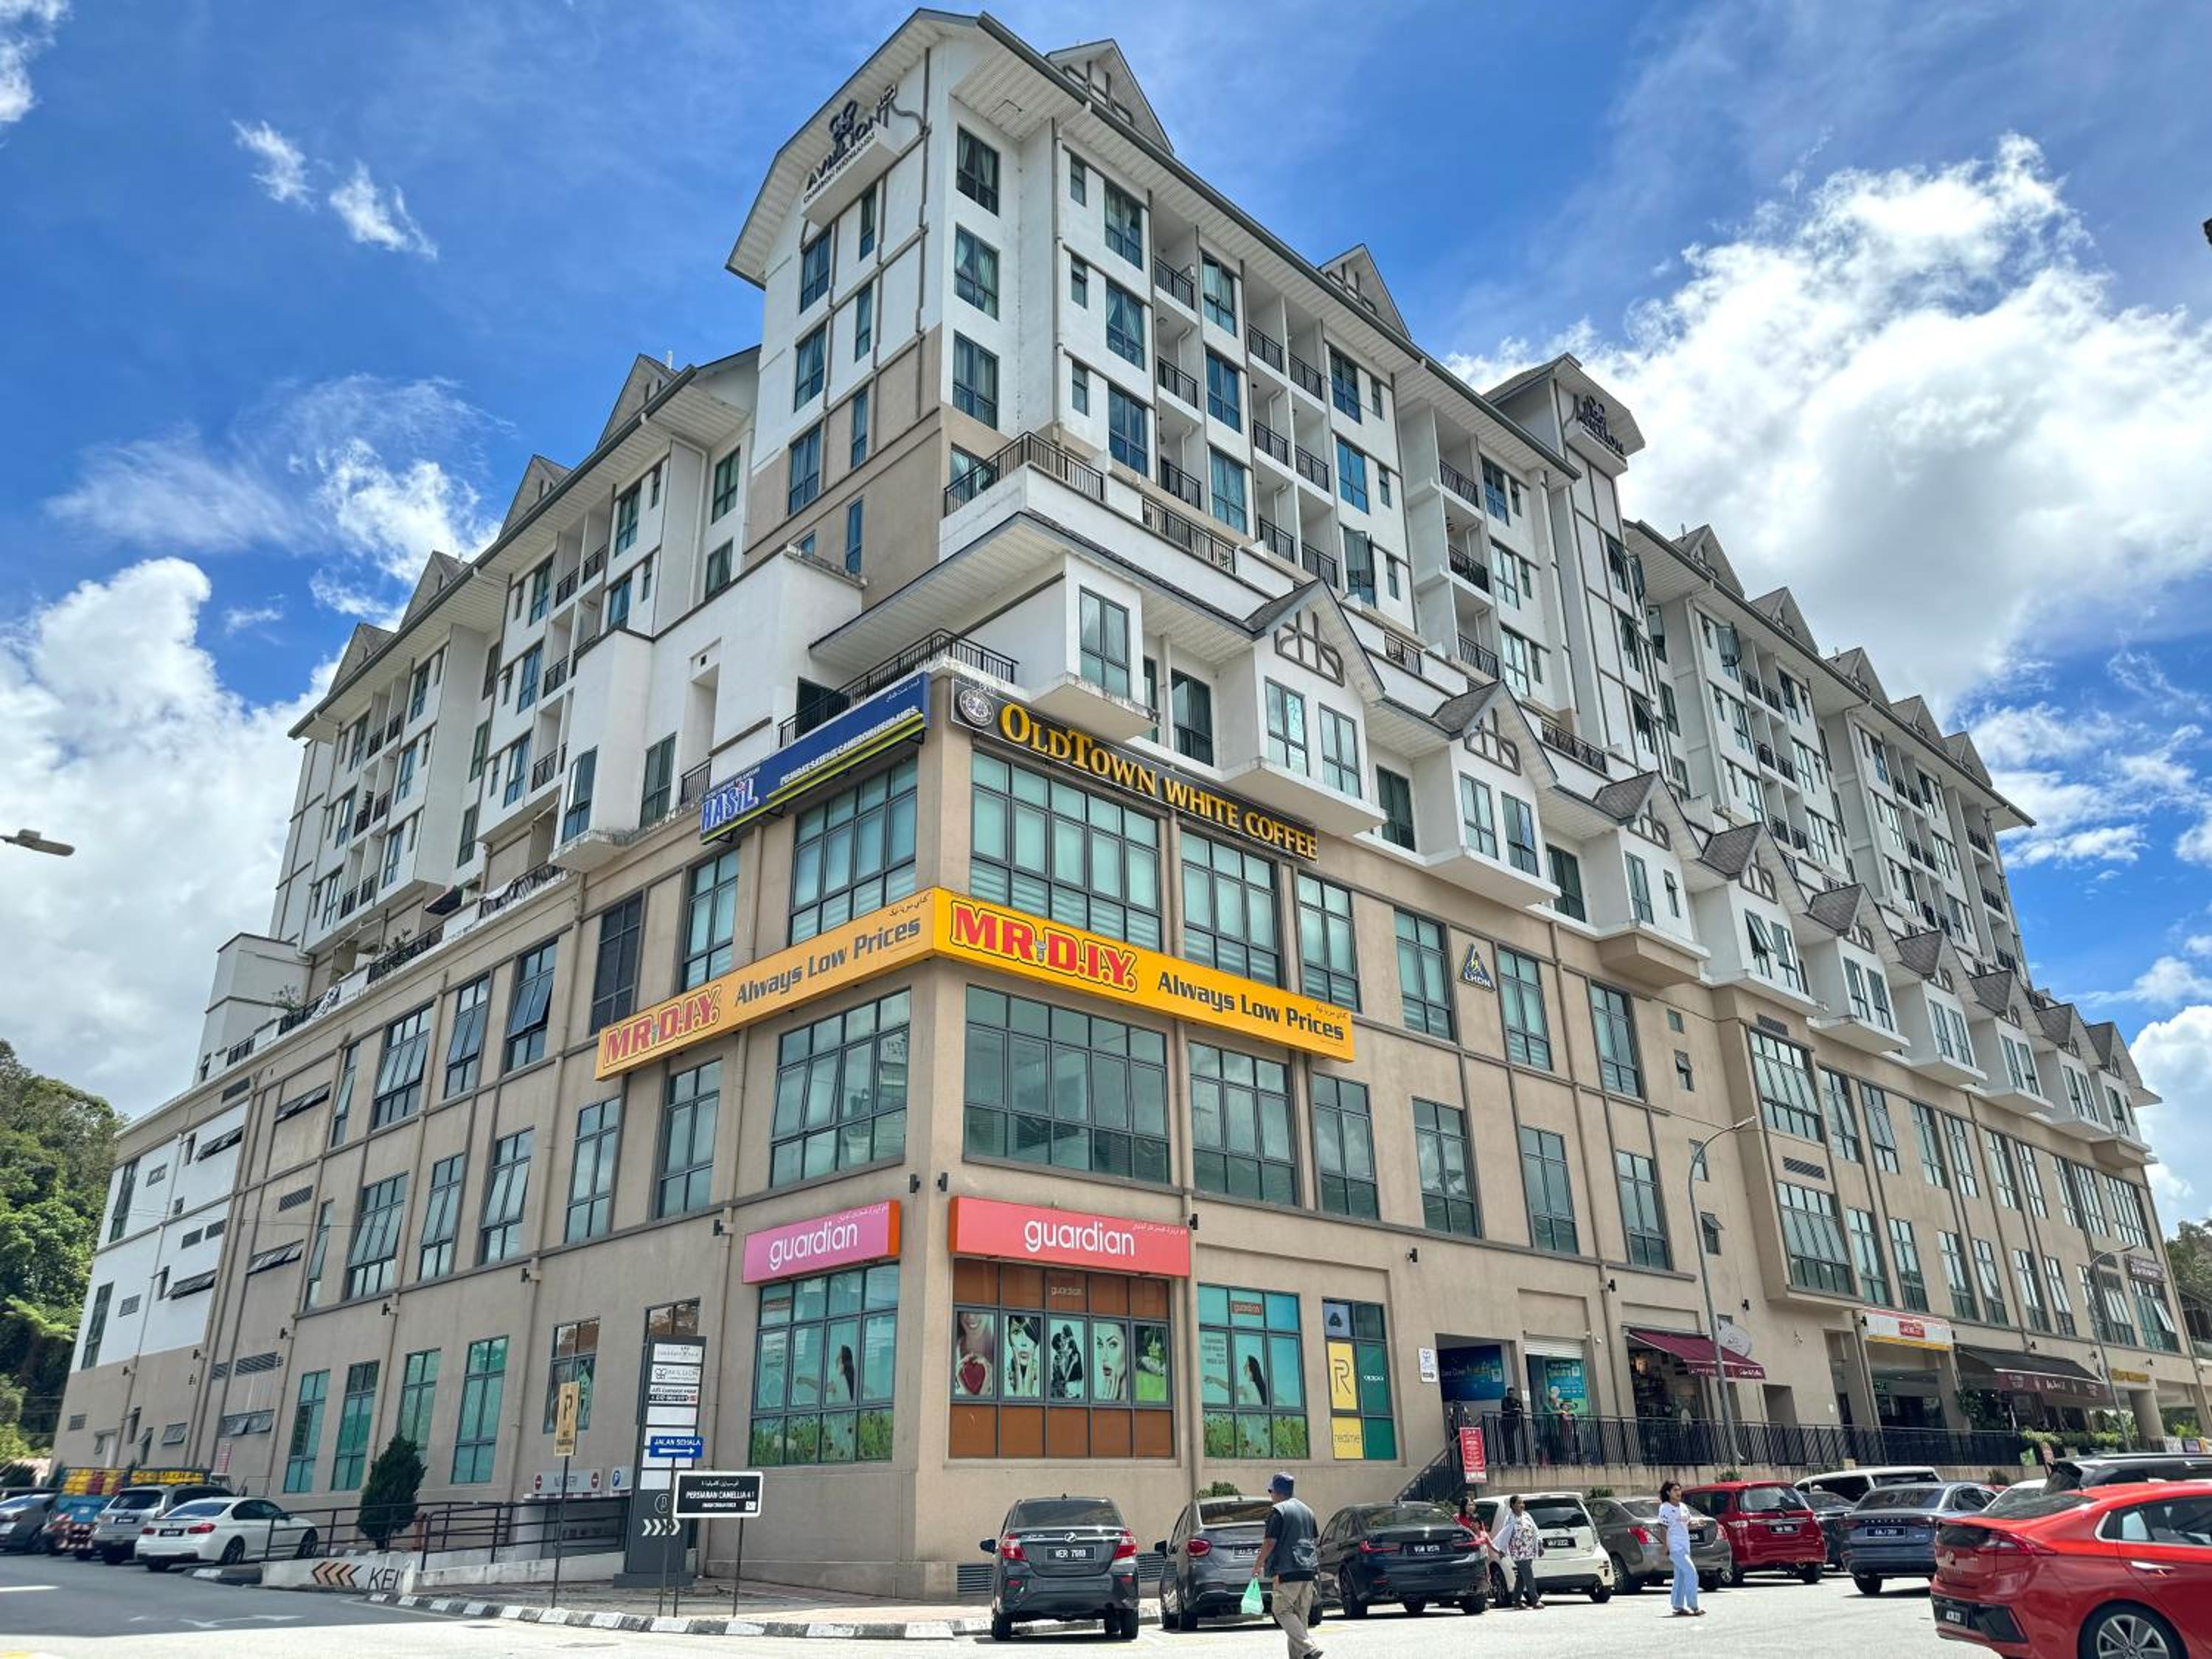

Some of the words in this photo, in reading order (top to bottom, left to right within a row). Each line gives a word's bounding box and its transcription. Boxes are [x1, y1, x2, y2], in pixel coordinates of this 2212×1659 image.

[1164, 776, 1239, 830] WHITE
[1244, 811, 1318, 858] COFFEE
[735, 966, 803, 1007] Always
[808, 947, 847, 980] Low
[853, 917, 921, 960] Prices
[1157, 971, 1236, 1012] Always
[1241, 993, 1281, 1023] Low
[1286, 1006, 1345, 1040] Prices
[769, 1221, 858, 1271] guardian
[1024, 1220, 1135, 1257] guardian
